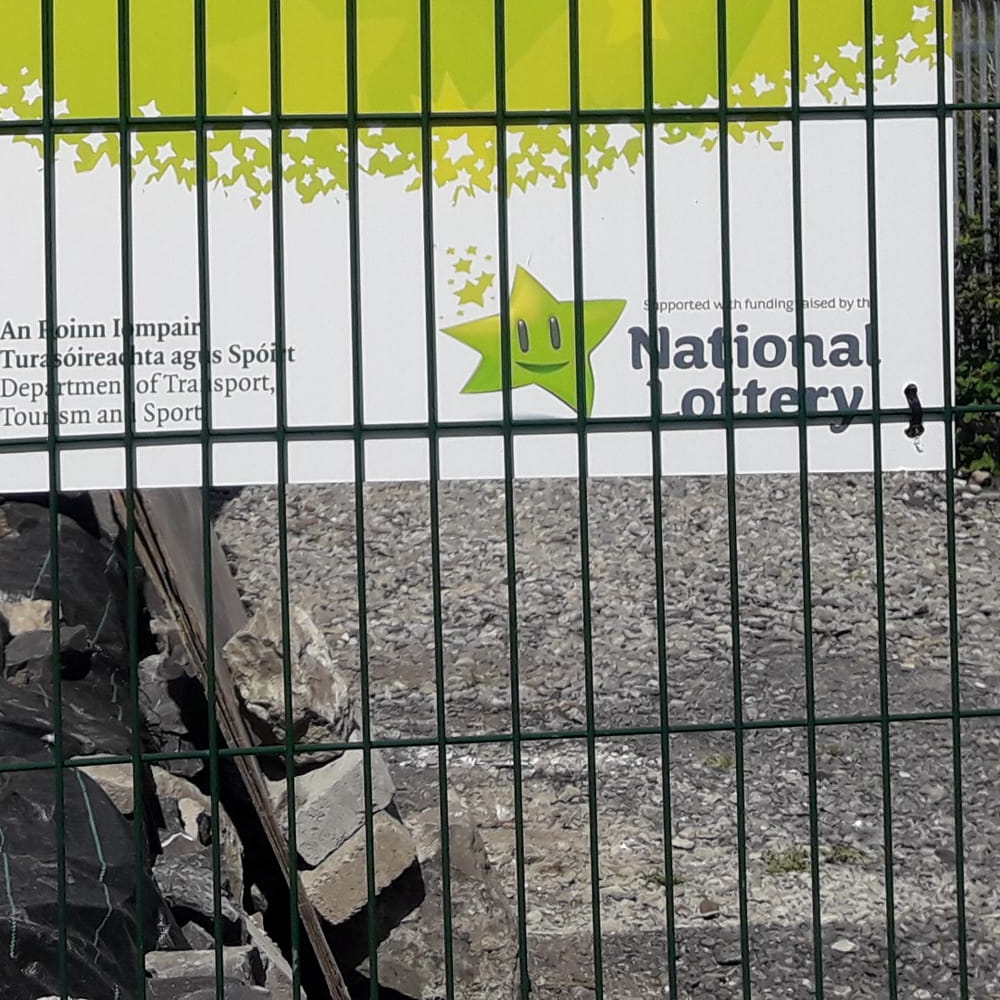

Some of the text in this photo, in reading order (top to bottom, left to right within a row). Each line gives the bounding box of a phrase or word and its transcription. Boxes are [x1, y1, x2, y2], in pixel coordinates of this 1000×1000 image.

[713, 299, 742, 310] wh
[744, 297, 794, 313] funding
[797, 297, 836, 309] aised
[838, 297, 854, 312] by
[856, 297, 876, 309] th
[0, 320, 32, 340] An
[228, 342, 296, 369] Spóit
[627, 323, 881, 370] National
[0, 378, 129, 402] Deprtmen
[136, 373, 162, 394] of
[0, 407, 91, 427] Toursm
[143, 402, 204, 428] Sport
